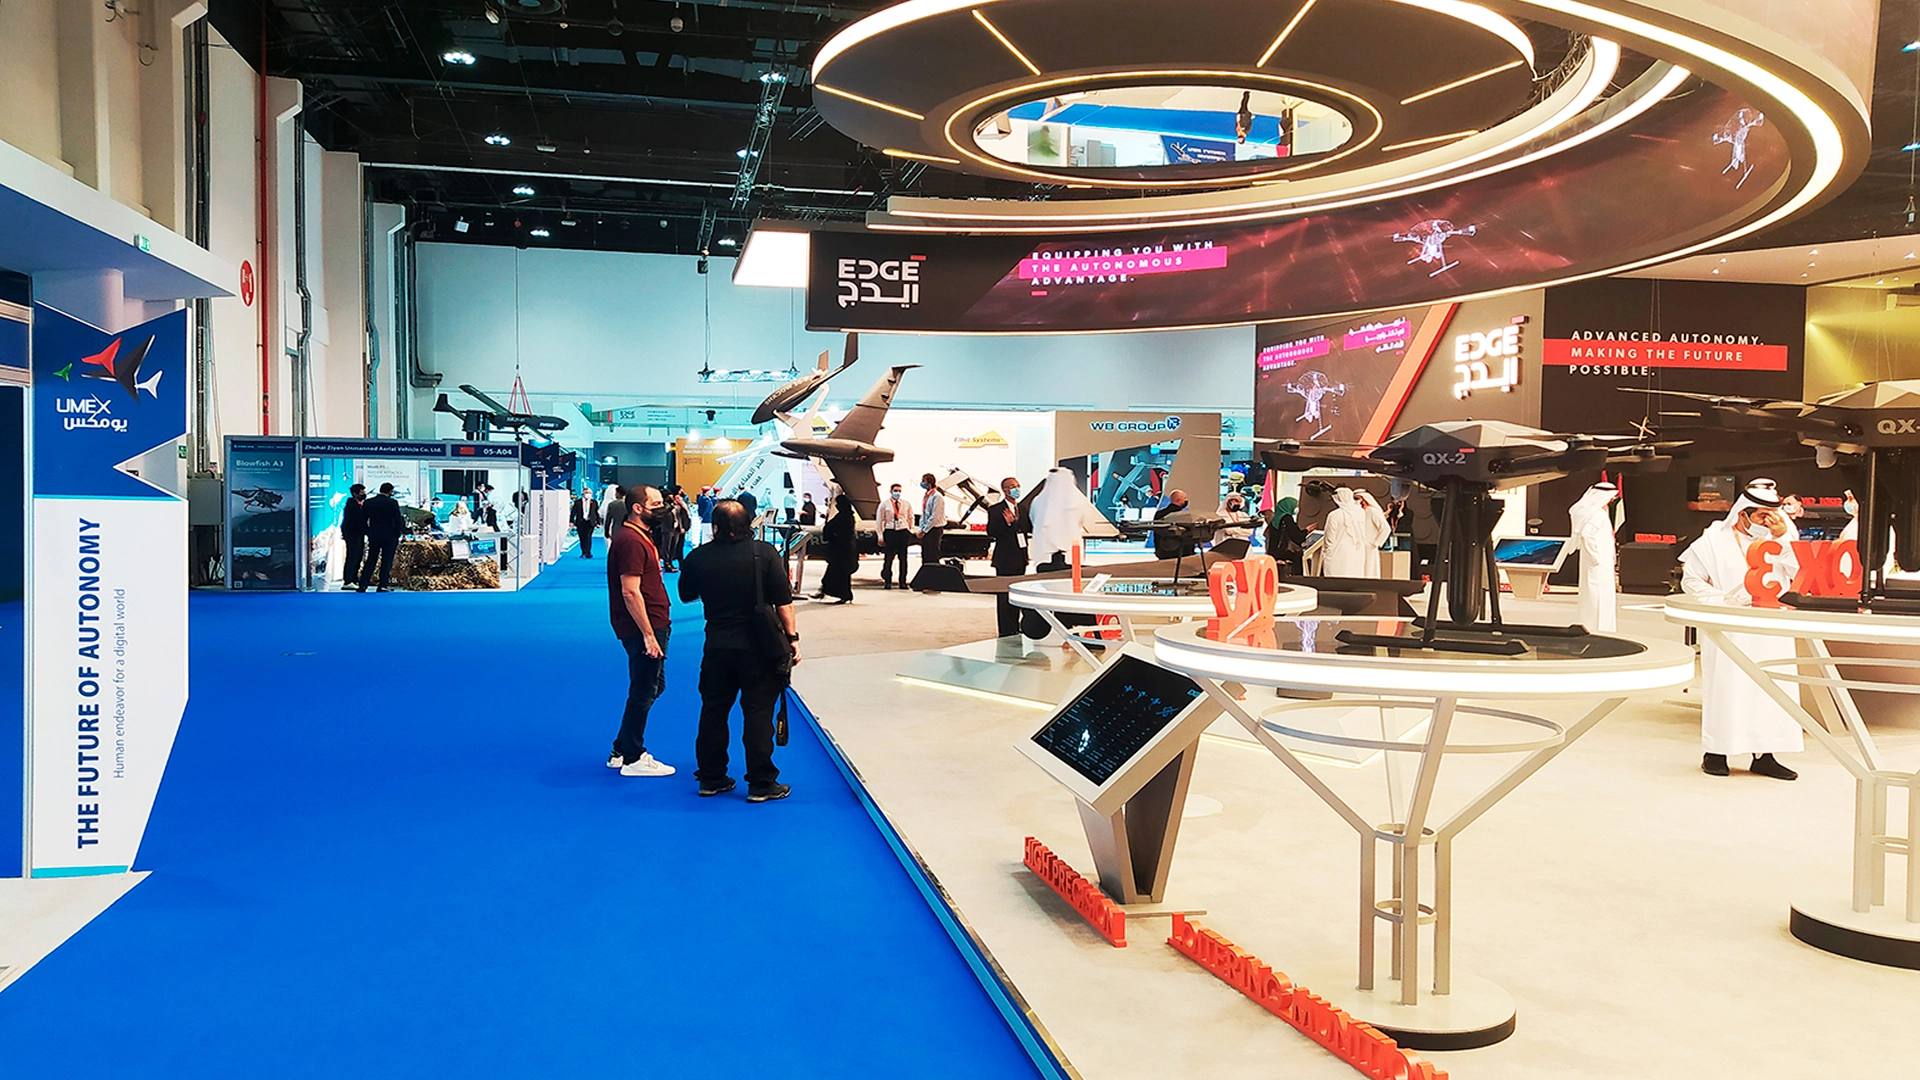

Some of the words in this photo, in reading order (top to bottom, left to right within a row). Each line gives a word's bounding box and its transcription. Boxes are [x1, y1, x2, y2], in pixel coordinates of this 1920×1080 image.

[1032, 248, 1123, 261] EQUIPPING
[1132, 245, 1164, 255] YOU
[1172, 240, 1214, 253] WITH
[838, 258, 920, 281] EDGE
[1031, 263, 1061, 273] THE
[1070, 256, 1183, 272] AUTONOMOUS
[1031, 273, 1135, 286] ADVANTAGE.
[1455, 325, 1519, 362] EDGE
[1571, 330, 1662, 342] ADVANCED
[1669, 333, 1765, 346] AUTONOMY.
[1571, 347, 1638, 359] MAKING
[1646, 349, 1675, 360] THE
[1683, 350, 1744, 362] FUTURE
[1569, 364, 1656, 377] POSSIBLE.
[56, 393, 112, 414] UMEX
[1091, 421, 1114, 431] WB
[1116, 422, 1166, 432] GROUP
[236, 459, 271, 467] Blowfish
[483, 448, 512, 456] 05-A04
[1423, 453, 1466, 465] QX-2
[78, 517, 100, 660] AUTONOMY
[113, 588, 126, 618] world
[114, 623, 129, 657] digital
[78, 666, 100, 697] OF
[113, 668, 126, 685] for
[113, 689, 126, 737] endeavor
[78, 704, 100, 796] FUTURE
[113, 738, 125, 779] Human
[77, 803, 99, 849] THE
[1024, 837, 1057, 880] HIGH
[1053, 860, 1125, 946] PRECISION
[1170, 912, 1294, 1019] LOITERING
